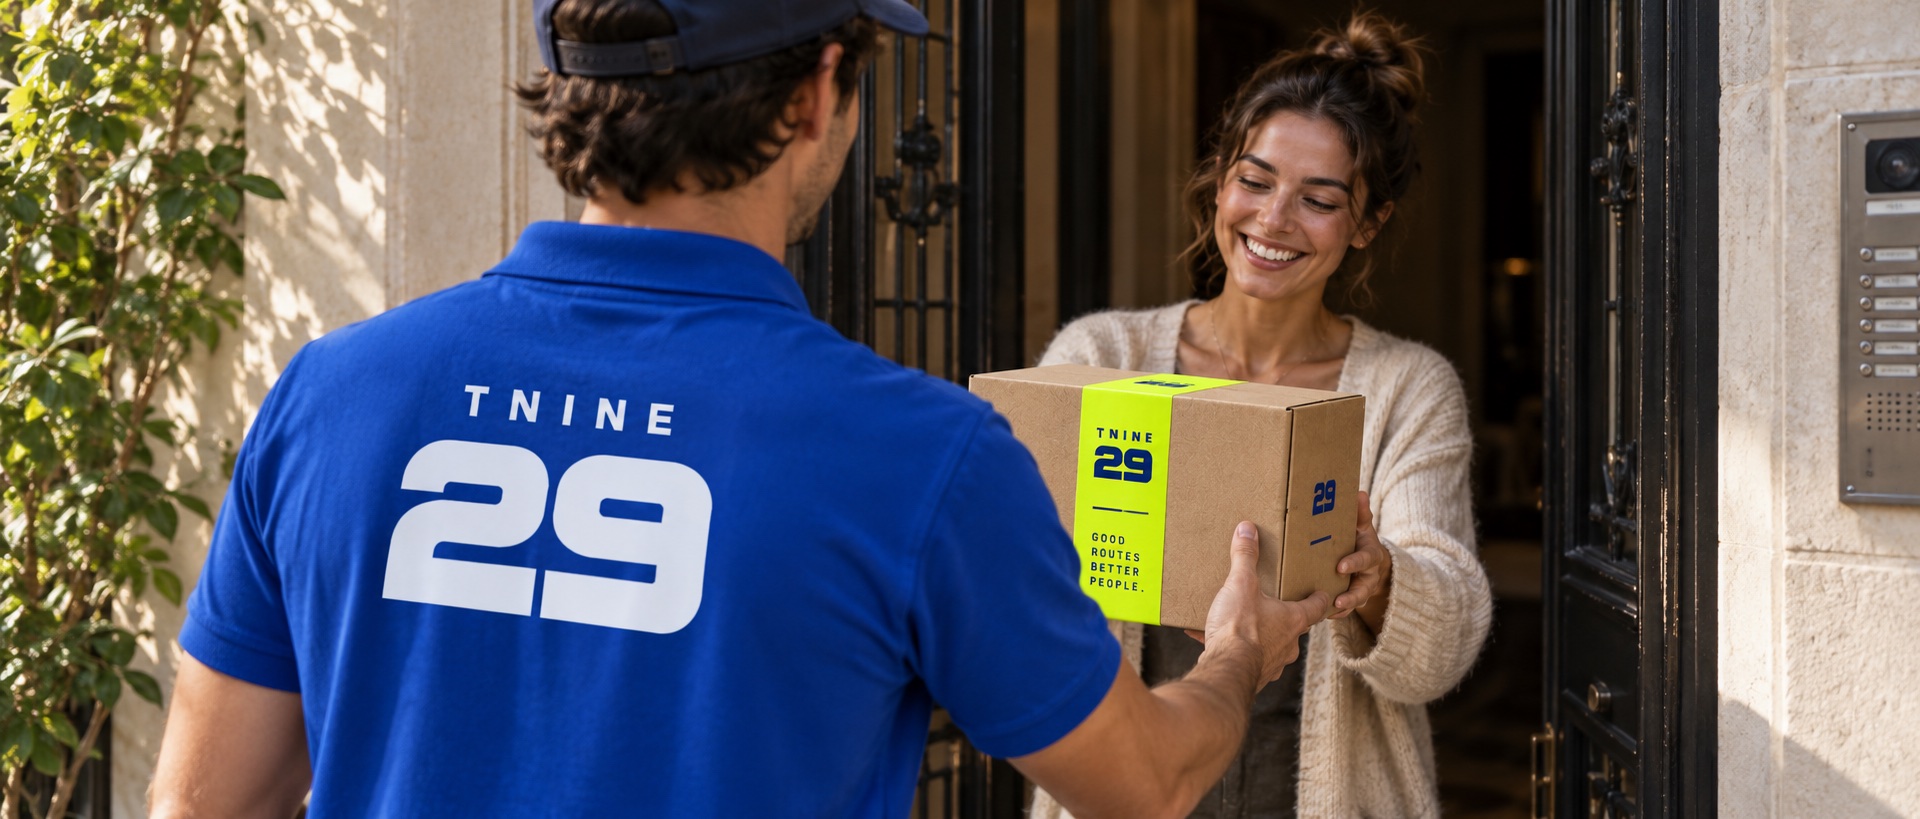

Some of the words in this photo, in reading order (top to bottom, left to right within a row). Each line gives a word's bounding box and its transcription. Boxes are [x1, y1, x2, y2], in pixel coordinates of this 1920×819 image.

[464, 384, 675, 436] TNINE
[1096, 427, 1153, 444] TNINE
[1093, 445, 1153, 484] 29
[1311, 479, 1336, 516] 29
[381, 439, 713, 635] 29
[1091, 532, 1125, 545] GOOD
[1091, 547, 1140, 562] ROUTES
[1090, 561, 1139, 577] BETTER
[1089, 576, 1144, 593] PEOPLE.
